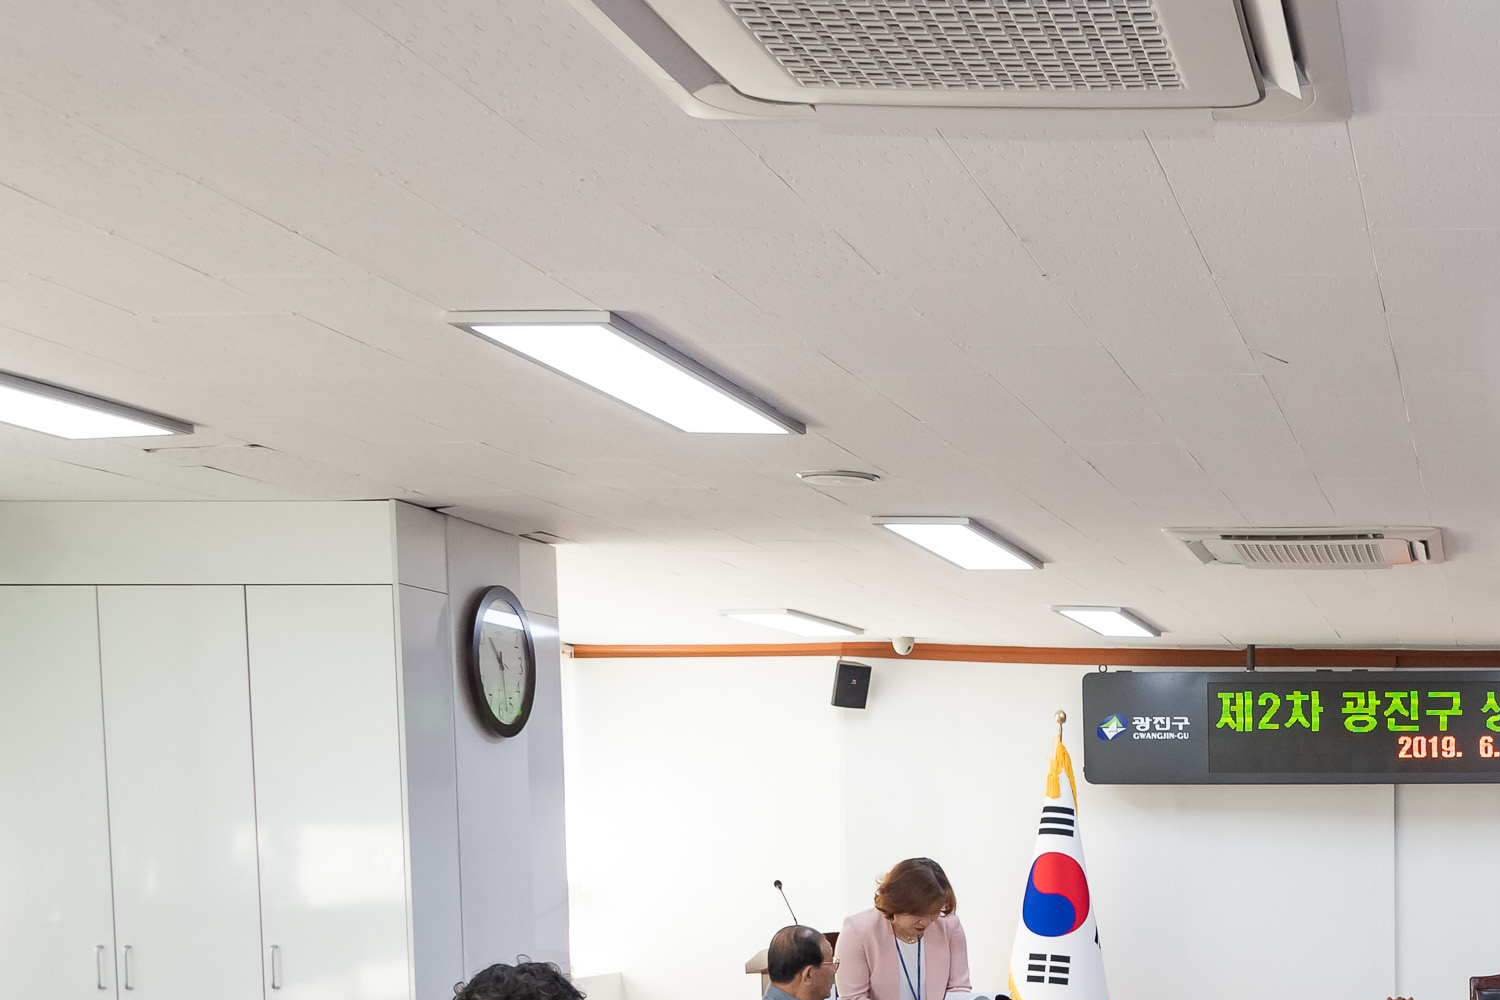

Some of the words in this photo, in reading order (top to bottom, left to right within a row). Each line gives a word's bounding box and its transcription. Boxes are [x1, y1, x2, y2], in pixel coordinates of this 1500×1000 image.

[1215, 690, 1324, 732] 제2차
[1341, 690, 1463, 733] 광진구
[1131, 716, 1191, 732] 광진구
[1132, 732, 1190, 740] GWANGJIN-GU
[1397, 735, 1463, 759] 2019.
